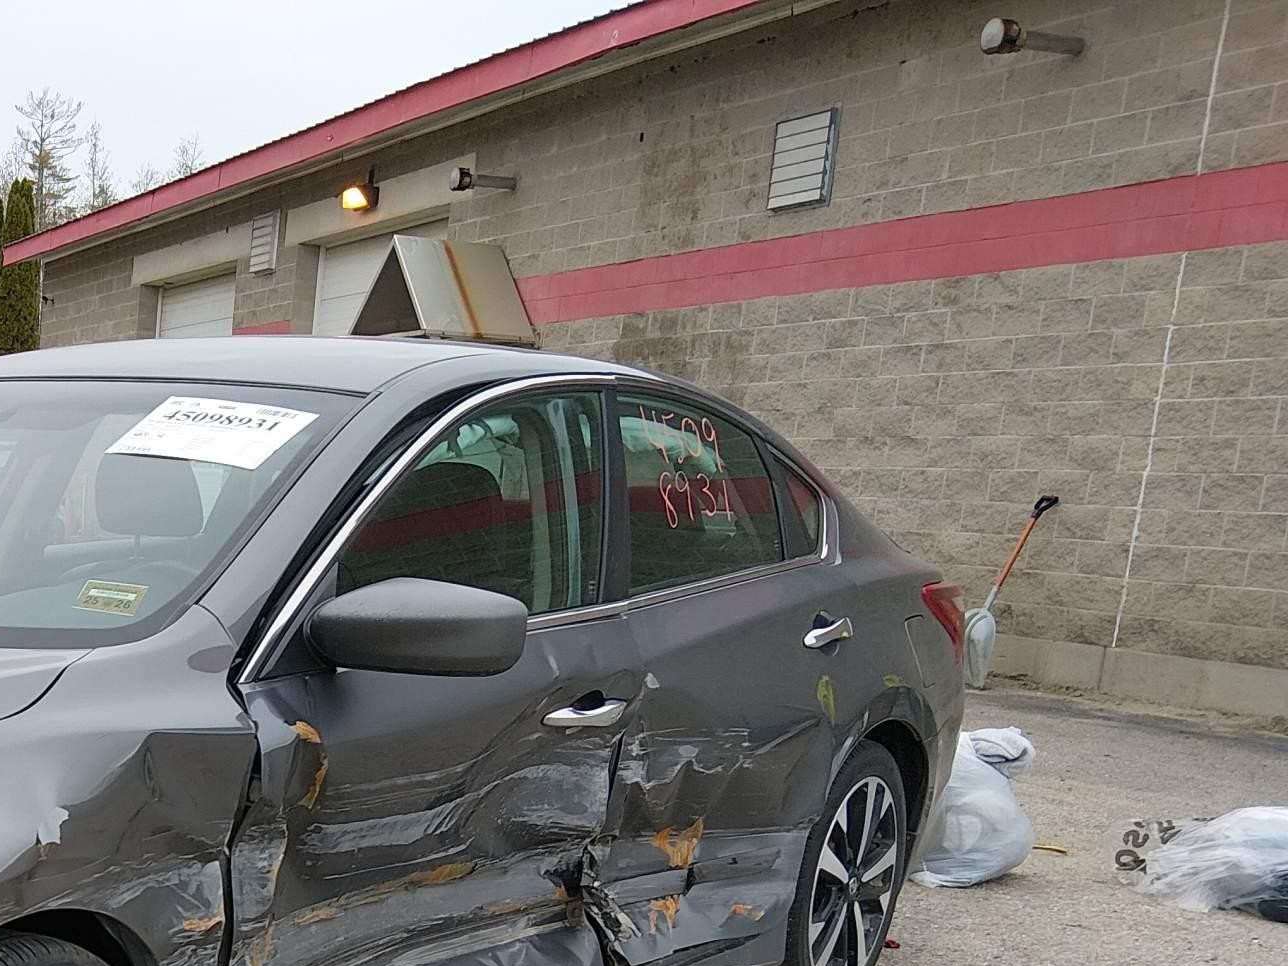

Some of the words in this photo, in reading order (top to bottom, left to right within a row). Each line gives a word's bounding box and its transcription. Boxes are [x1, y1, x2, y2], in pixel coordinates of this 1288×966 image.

[163, 409, 281, 432] 45098931
[640, 405, 724, 473] 4509
[658, 470, 732, 529] 8931
